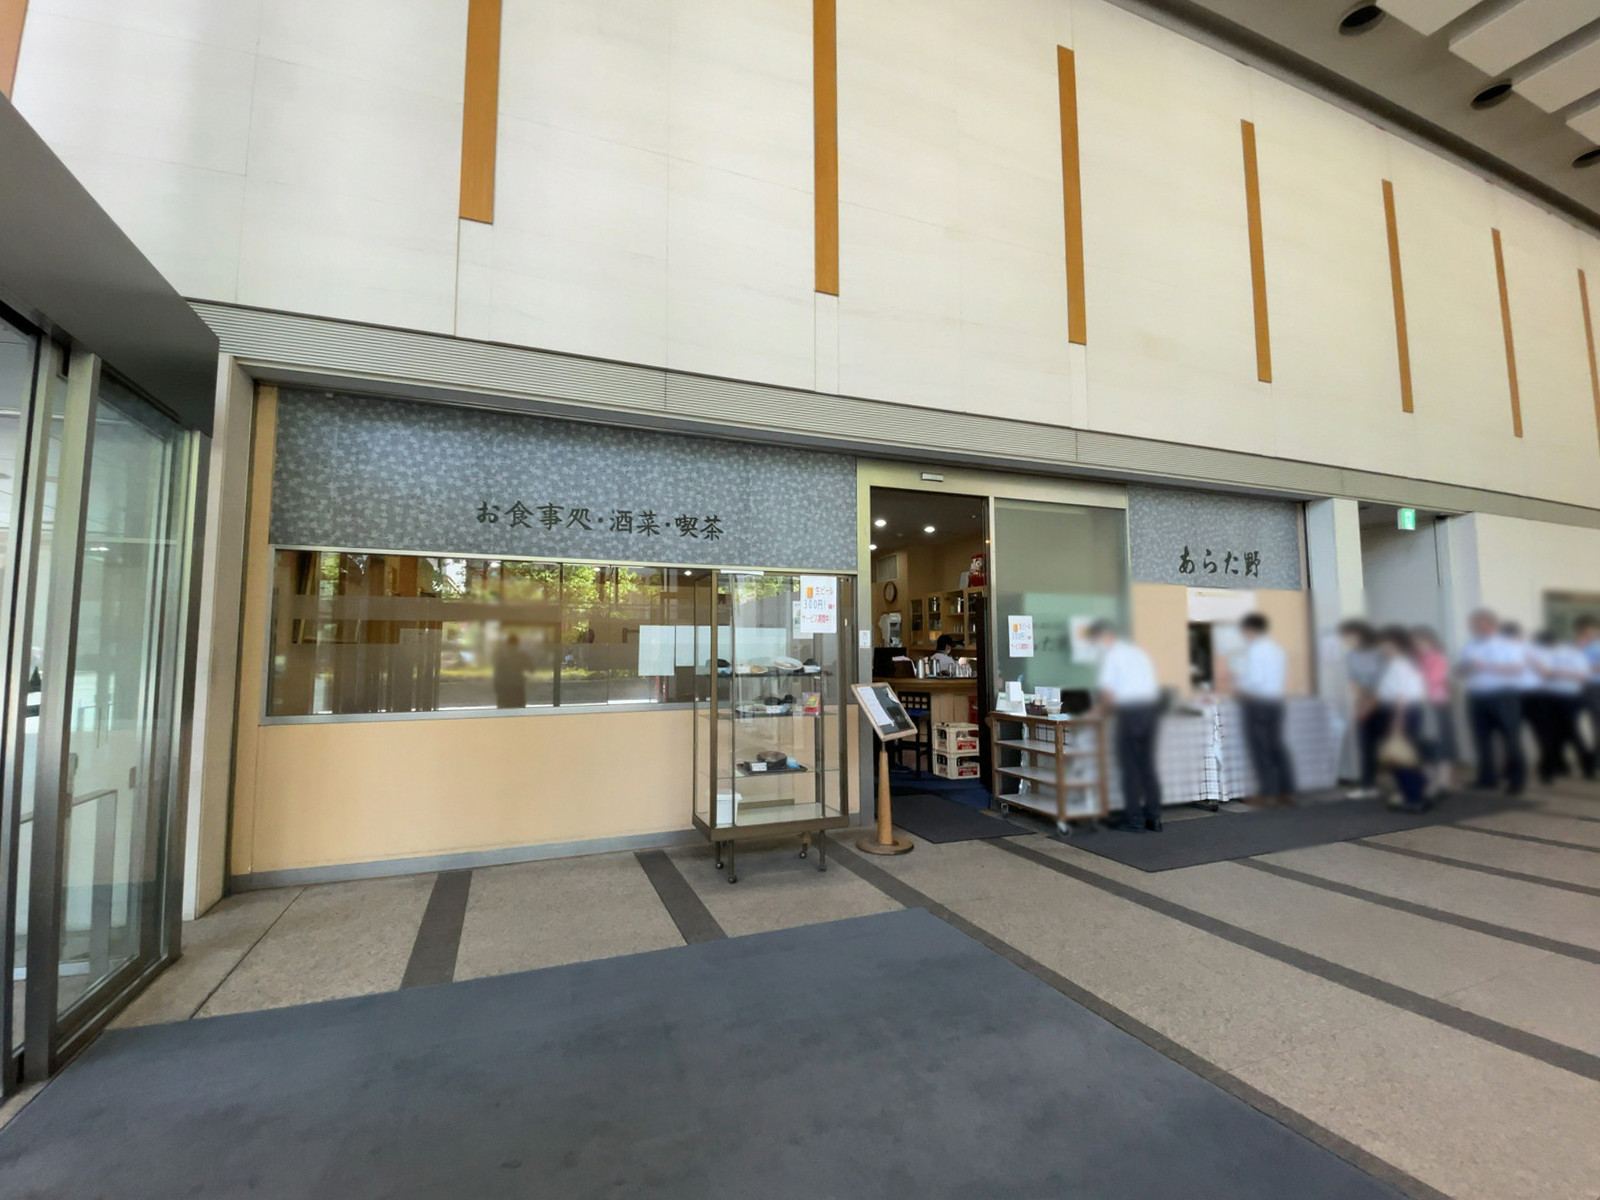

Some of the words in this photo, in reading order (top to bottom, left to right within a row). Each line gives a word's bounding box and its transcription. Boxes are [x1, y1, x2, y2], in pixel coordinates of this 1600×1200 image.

[476, 500, 724, 541] お食事処・酒菜・喫茶
[1179, 545, 1261, 578] あらた野
